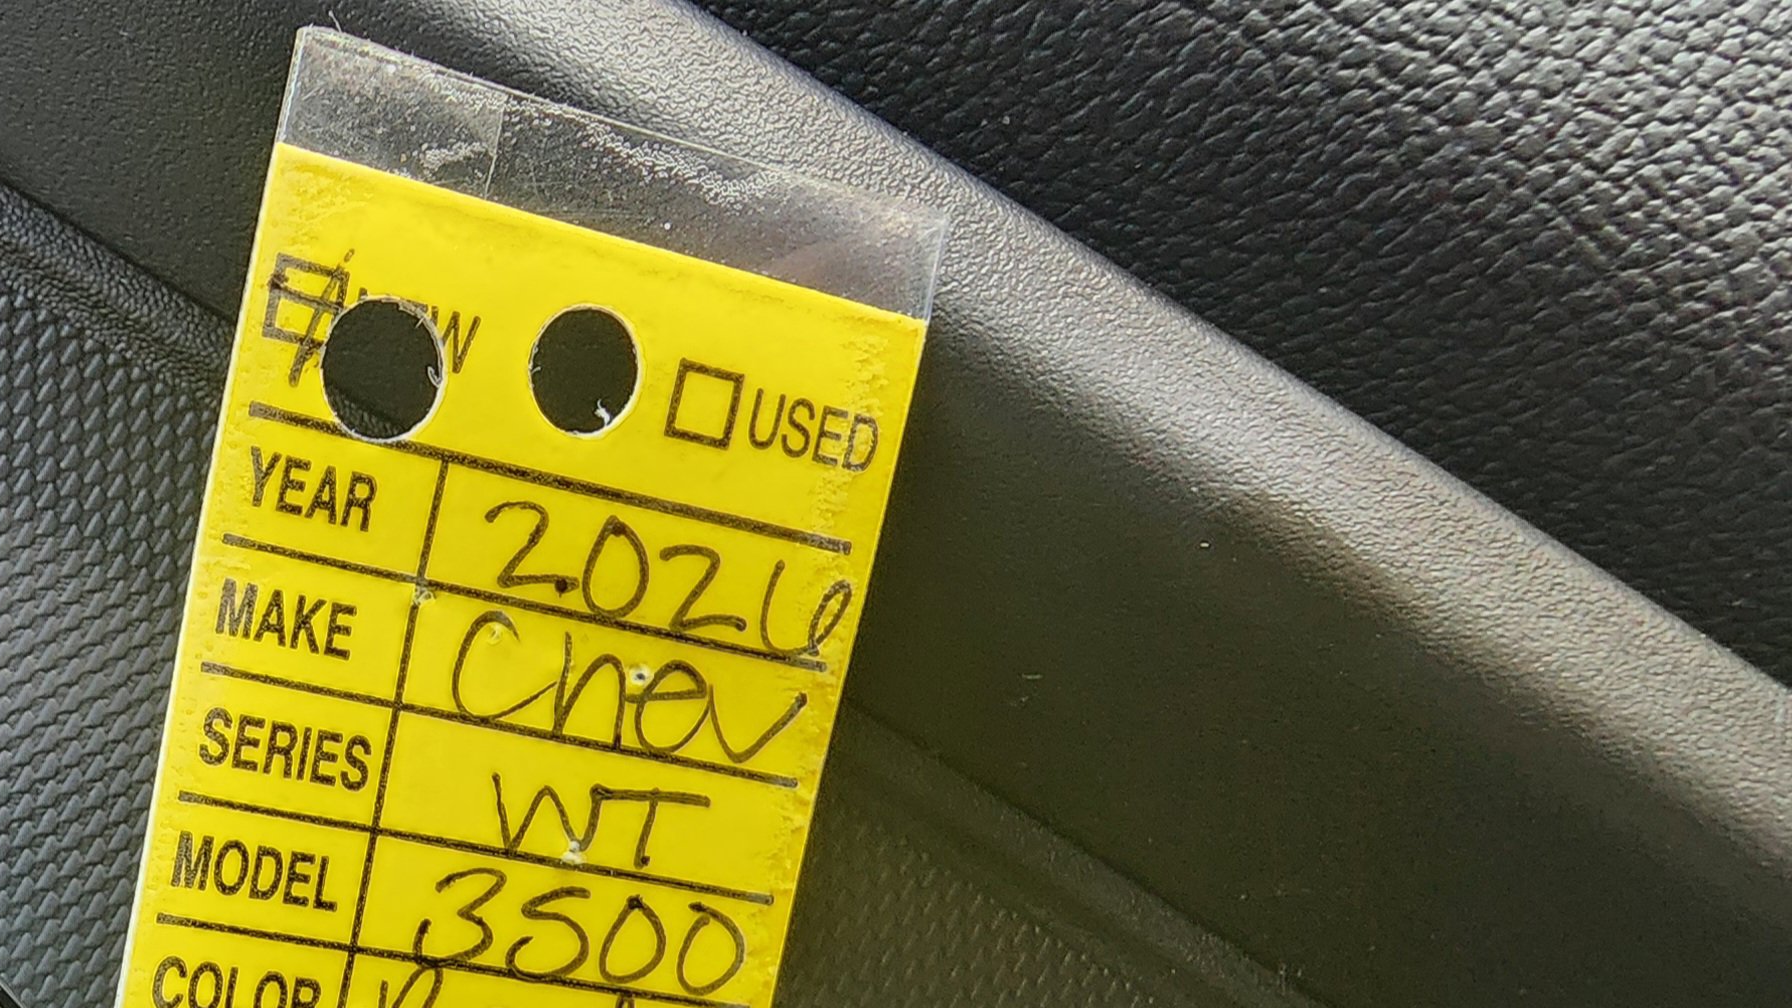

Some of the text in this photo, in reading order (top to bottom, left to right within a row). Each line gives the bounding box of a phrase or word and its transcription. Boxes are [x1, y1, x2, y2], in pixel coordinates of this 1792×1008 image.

[748, 387, 880, 473] USED
[249, 445, 378, 532] YEAR
[214, 577, 359, 660] MAKE
[483, 500, 853, 657] 2026
[450, 609, 808, 763] Chev
[197, 707, 373, 792] SERIES
[491, 772, 712, 869] WT
[170, 831, 338, 912] MODEL
[414, 867, 746, 996] 3500
